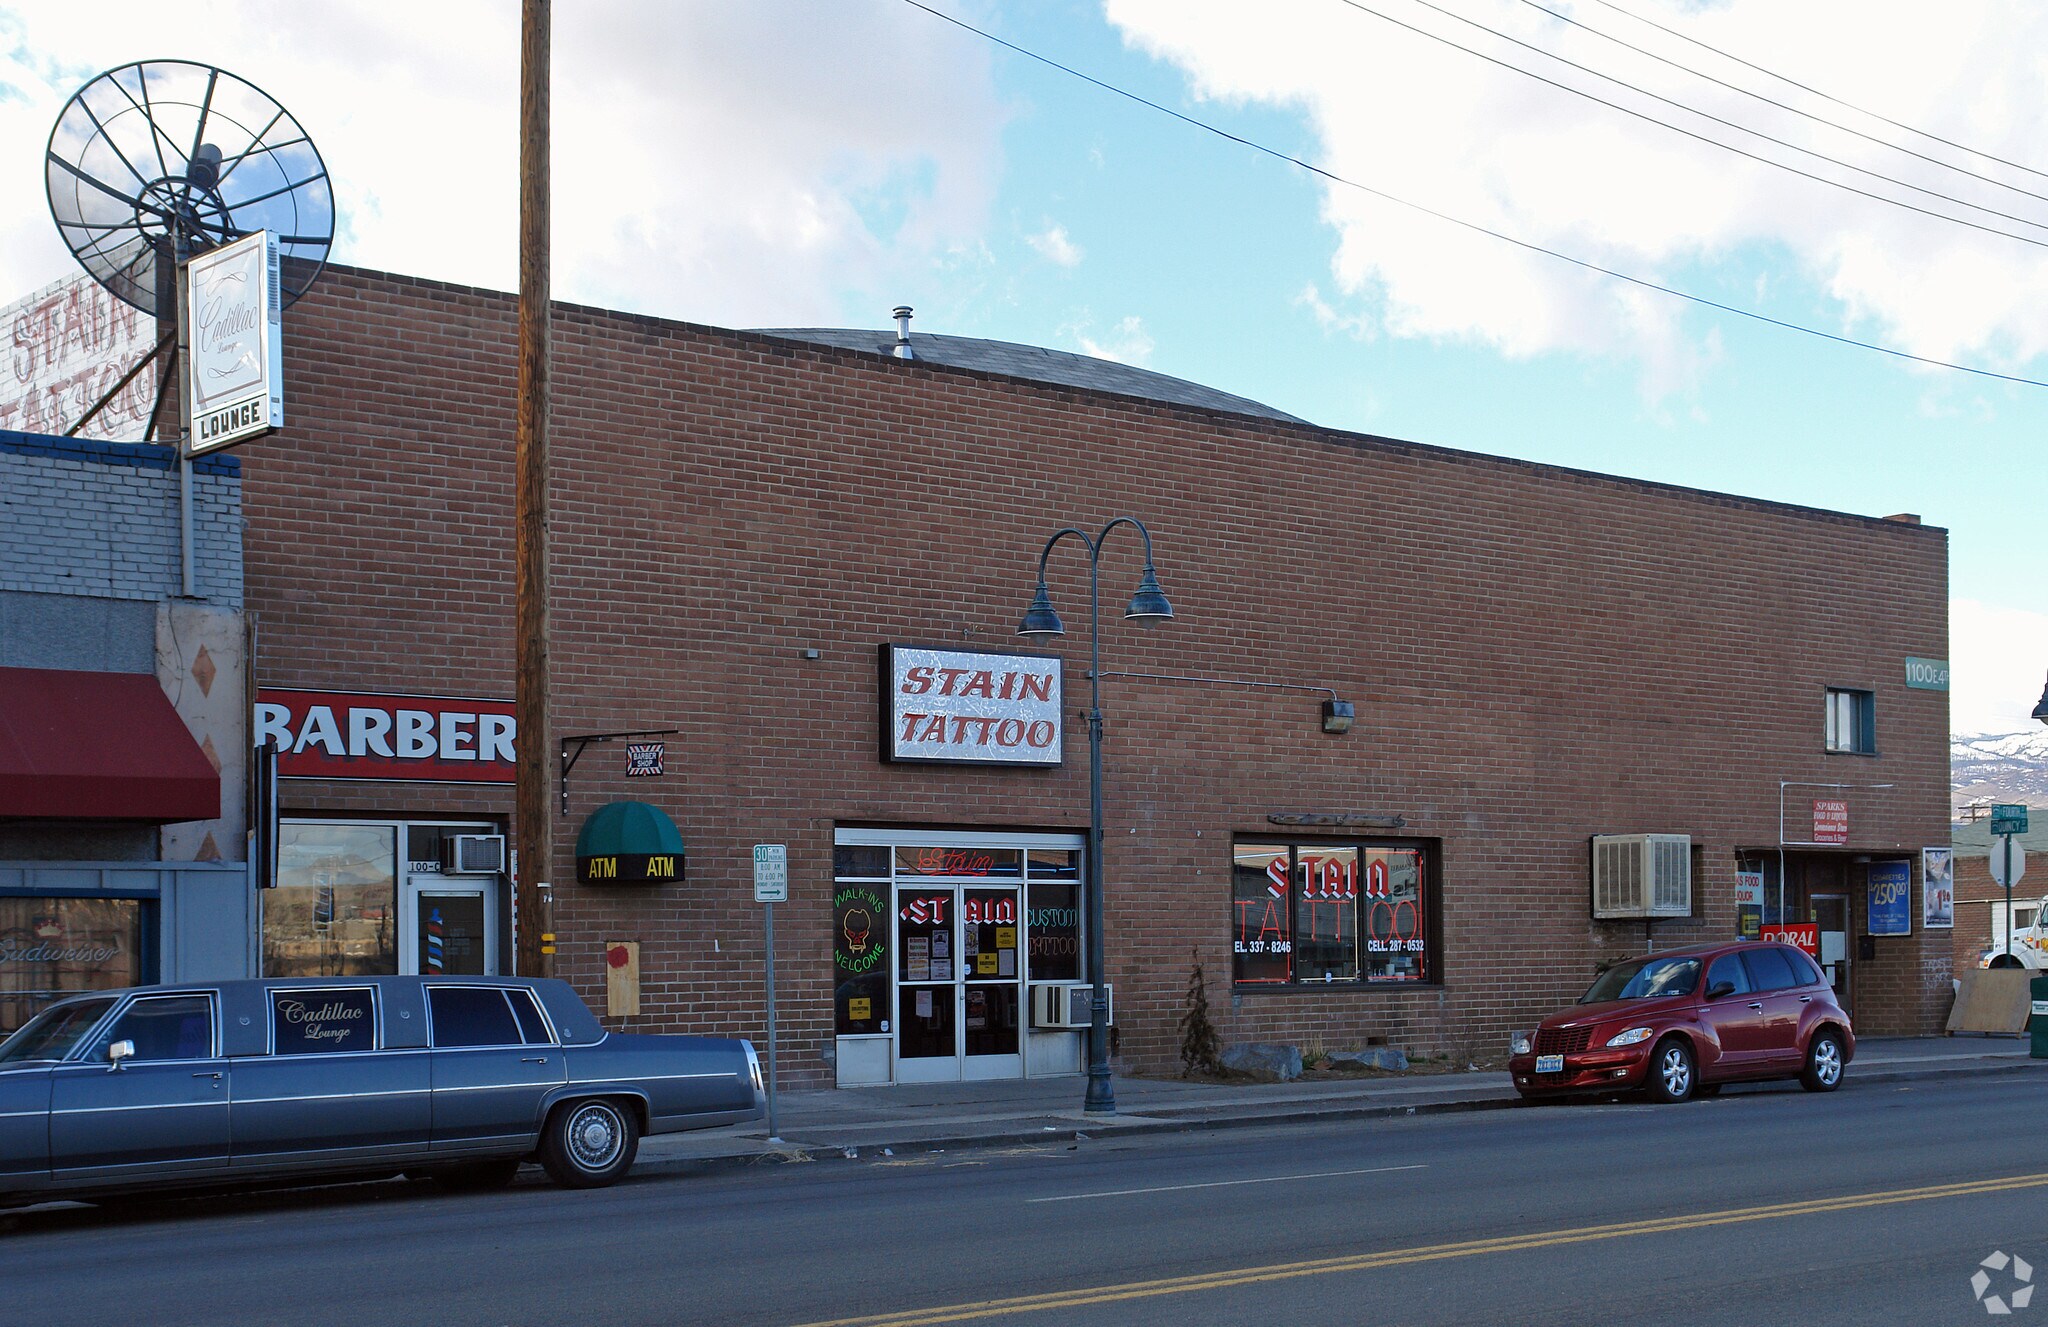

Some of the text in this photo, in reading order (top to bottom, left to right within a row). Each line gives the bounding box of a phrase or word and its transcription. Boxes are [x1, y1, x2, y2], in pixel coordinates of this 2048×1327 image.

[199, 295, 258, 353] Cadillac
[200, 401, 261, 440] LOUNGE
[1906, 662, 1933, 683] 1100
[901, 666, 1054, 703] STAIN
[254, 702, 517, 763] BARBER
[901, 712, 1056, 749] TATTOO
[633, 752, 657, 761] BARBER
[637, 760, 653, 768] SHOP
[1815, 801, 1846, 811] SPARKS
[755, 847, 768, 861] 30
[410, 862, 440, 872] 100-C
[589, 856, 674, 879] ATM ATM
[1745, 876, 1760, 887] FOOD
[835, 888, 884, 913] WALK-INS
[1028, 908, 1077, 928] CUSTOM
[1234, 900, 1418, 943] TATTOO
[1028, 936, 1077, 957] TATTOO
[1234, 940, 1248, 953] EL.
[1367, 940, 1388, 952] CELL.
[1763, 930, 1816, 948] DORAL
[0, 938, 121, 965] Budweiser
[277, 999, 364, 1023] Cadillac
[304, 1023, 351, 1043] Lounge
